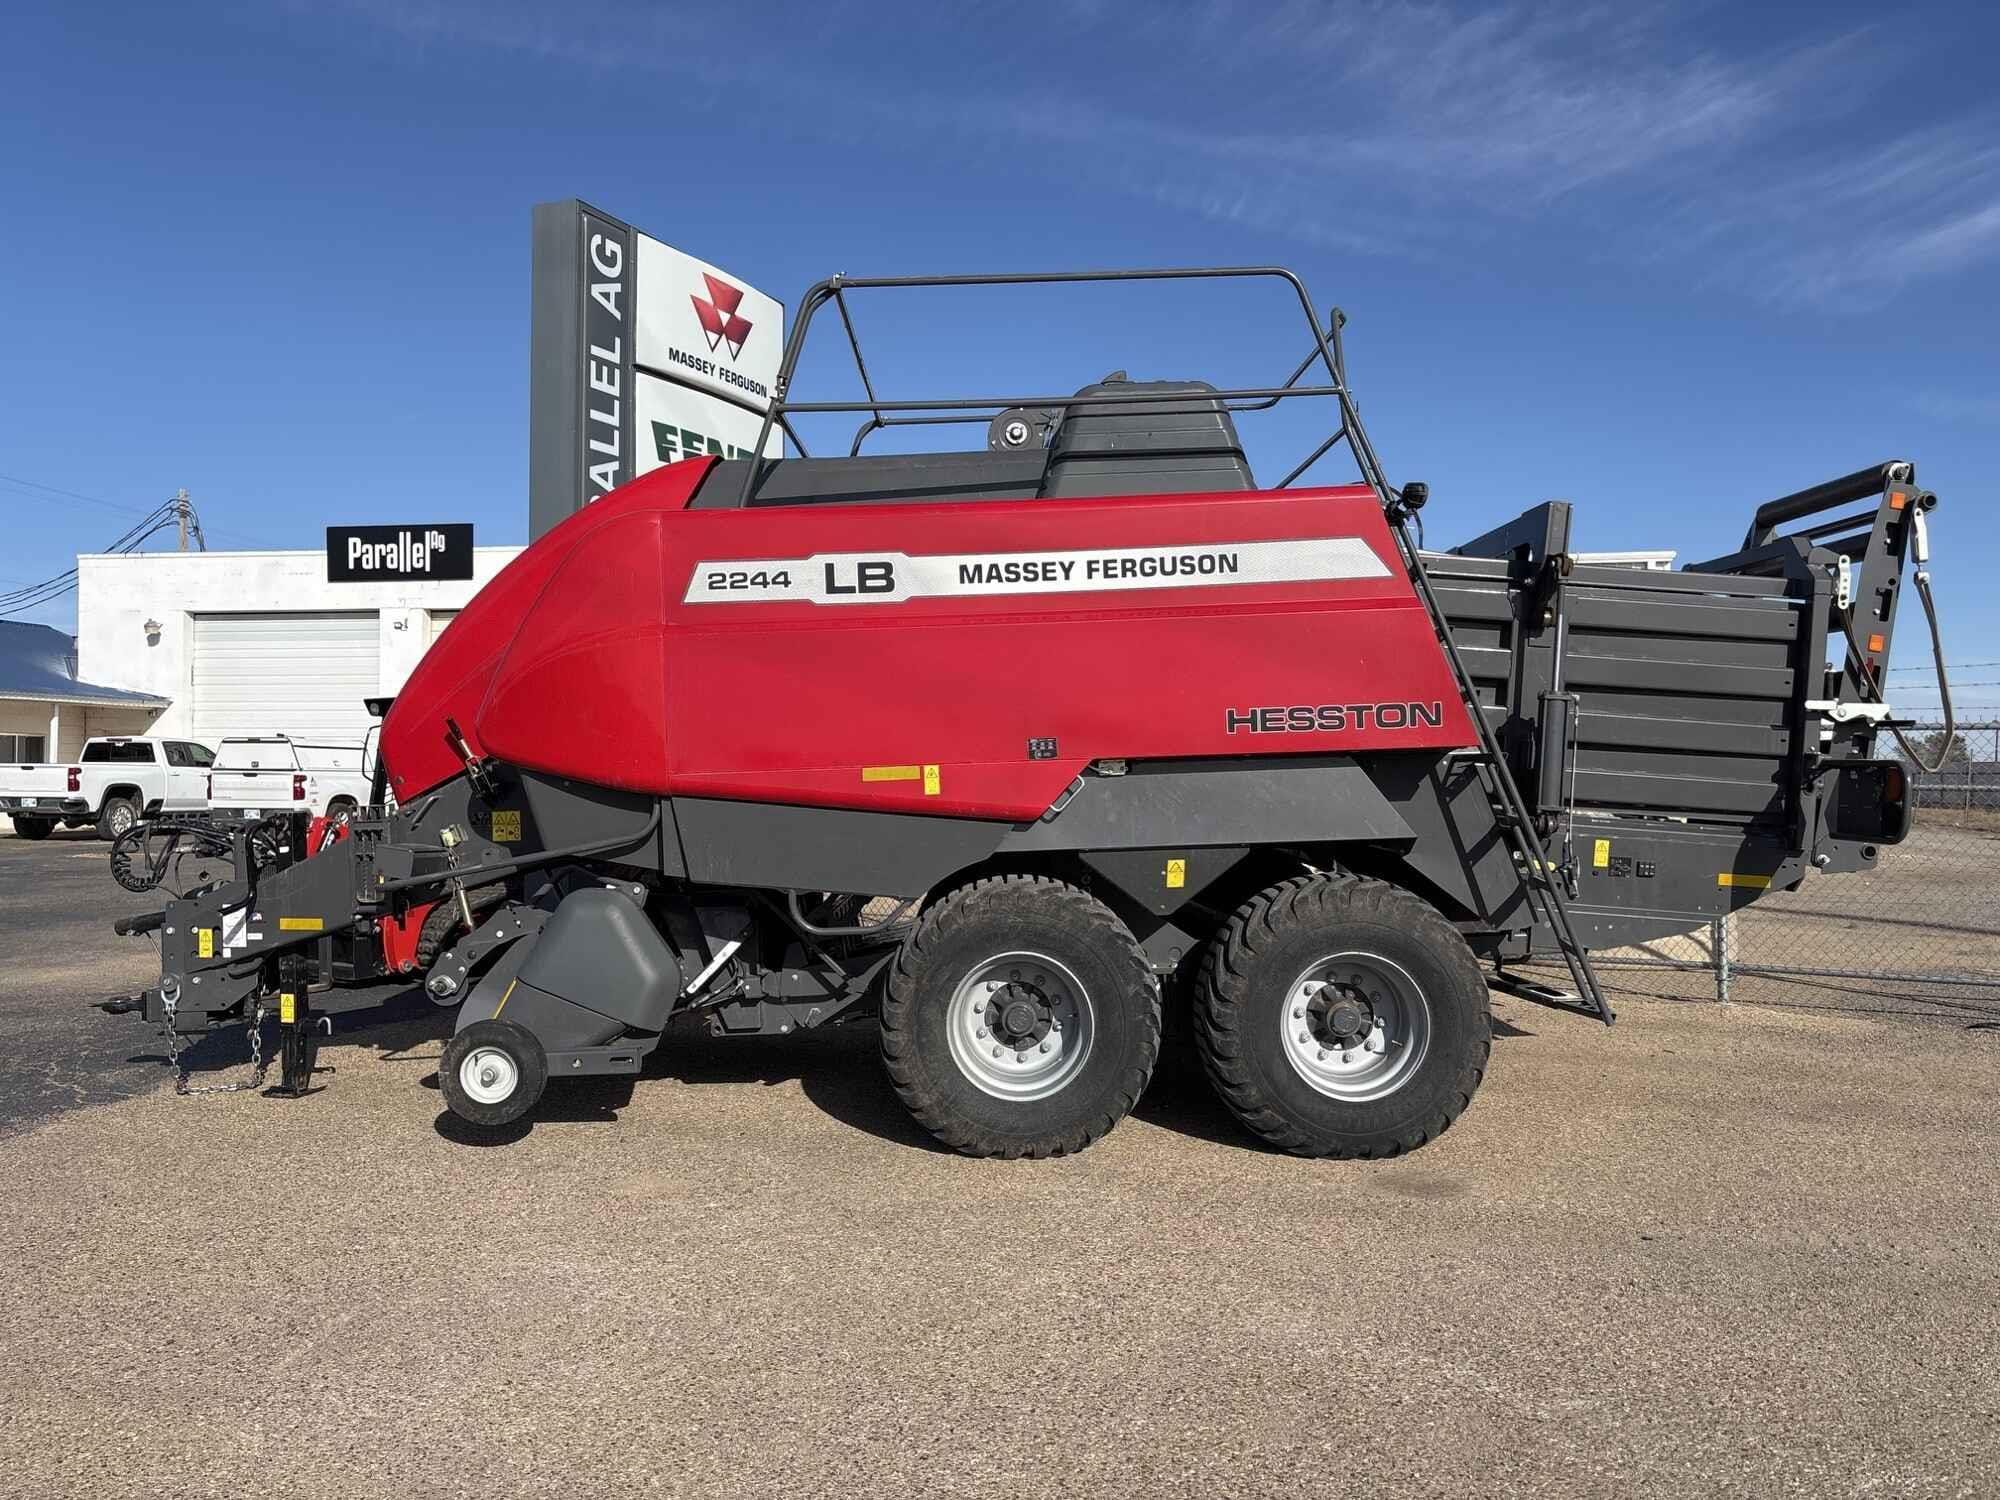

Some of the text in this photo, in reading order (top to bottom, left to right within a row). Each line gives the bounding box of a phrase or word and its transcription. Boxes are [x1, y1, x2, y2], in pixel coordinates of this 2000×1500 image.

[589, 233, 622, 503] ALLEL AG
[668, 347, 768, 398] MASSEY FERGUSON
[347, 531, 431, 573] Parallel
[707, 553, 1239, 595] 2244 LB MASSEY FERGUSON
[1226, 701, 1444, 734] HESSTON
